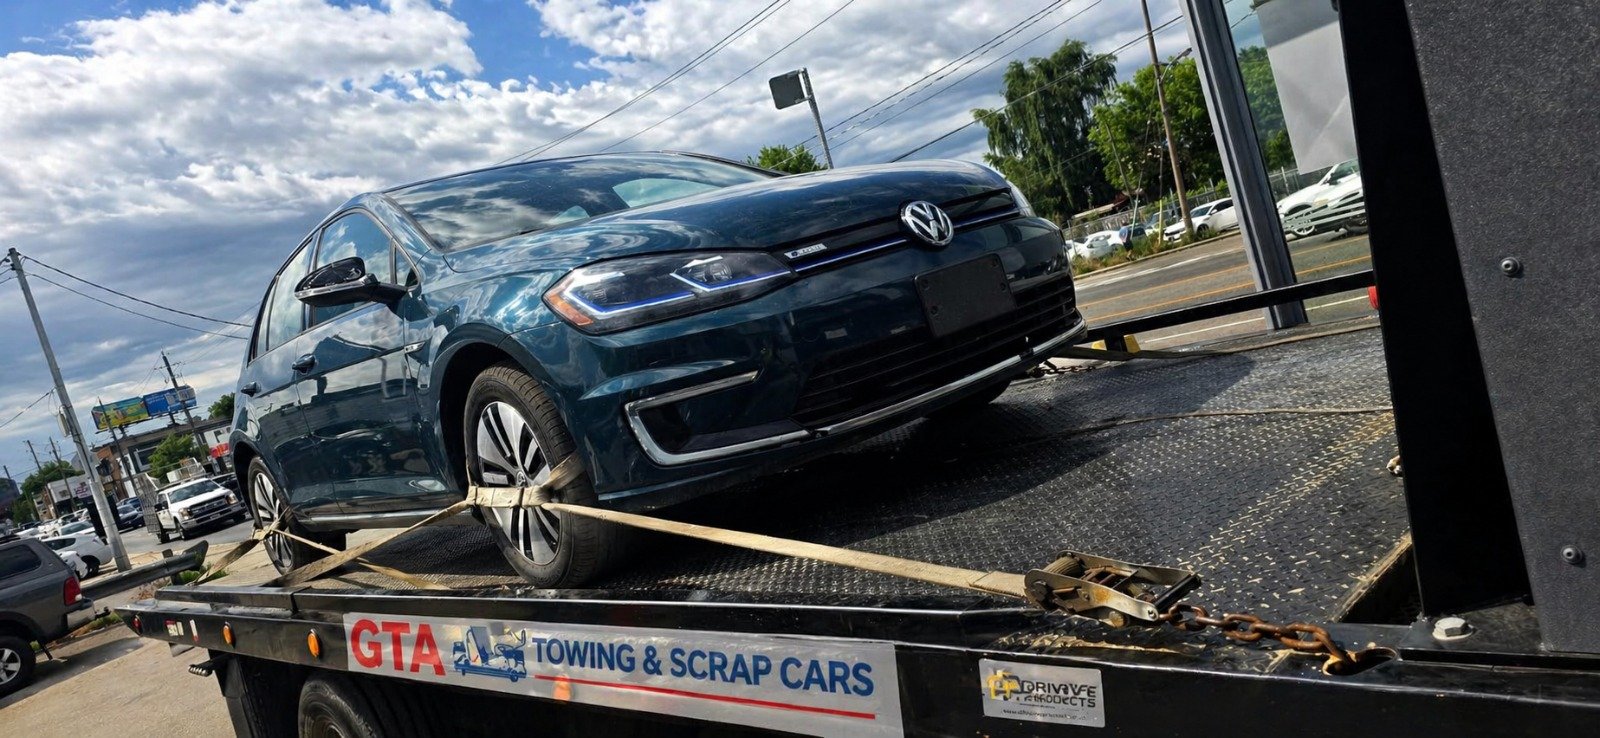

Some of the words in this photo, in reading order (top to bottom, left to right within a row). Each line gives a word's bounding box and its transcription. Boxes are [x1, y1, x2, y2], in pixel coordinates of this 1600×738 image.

[350, 619, 446, 676] GTA
[532, 637, 636, 673] TOWING
[643, 645, 662, 676] &
[670, 648, 772, 685] SCRAP
[780, 657, 875, 697] CARS
